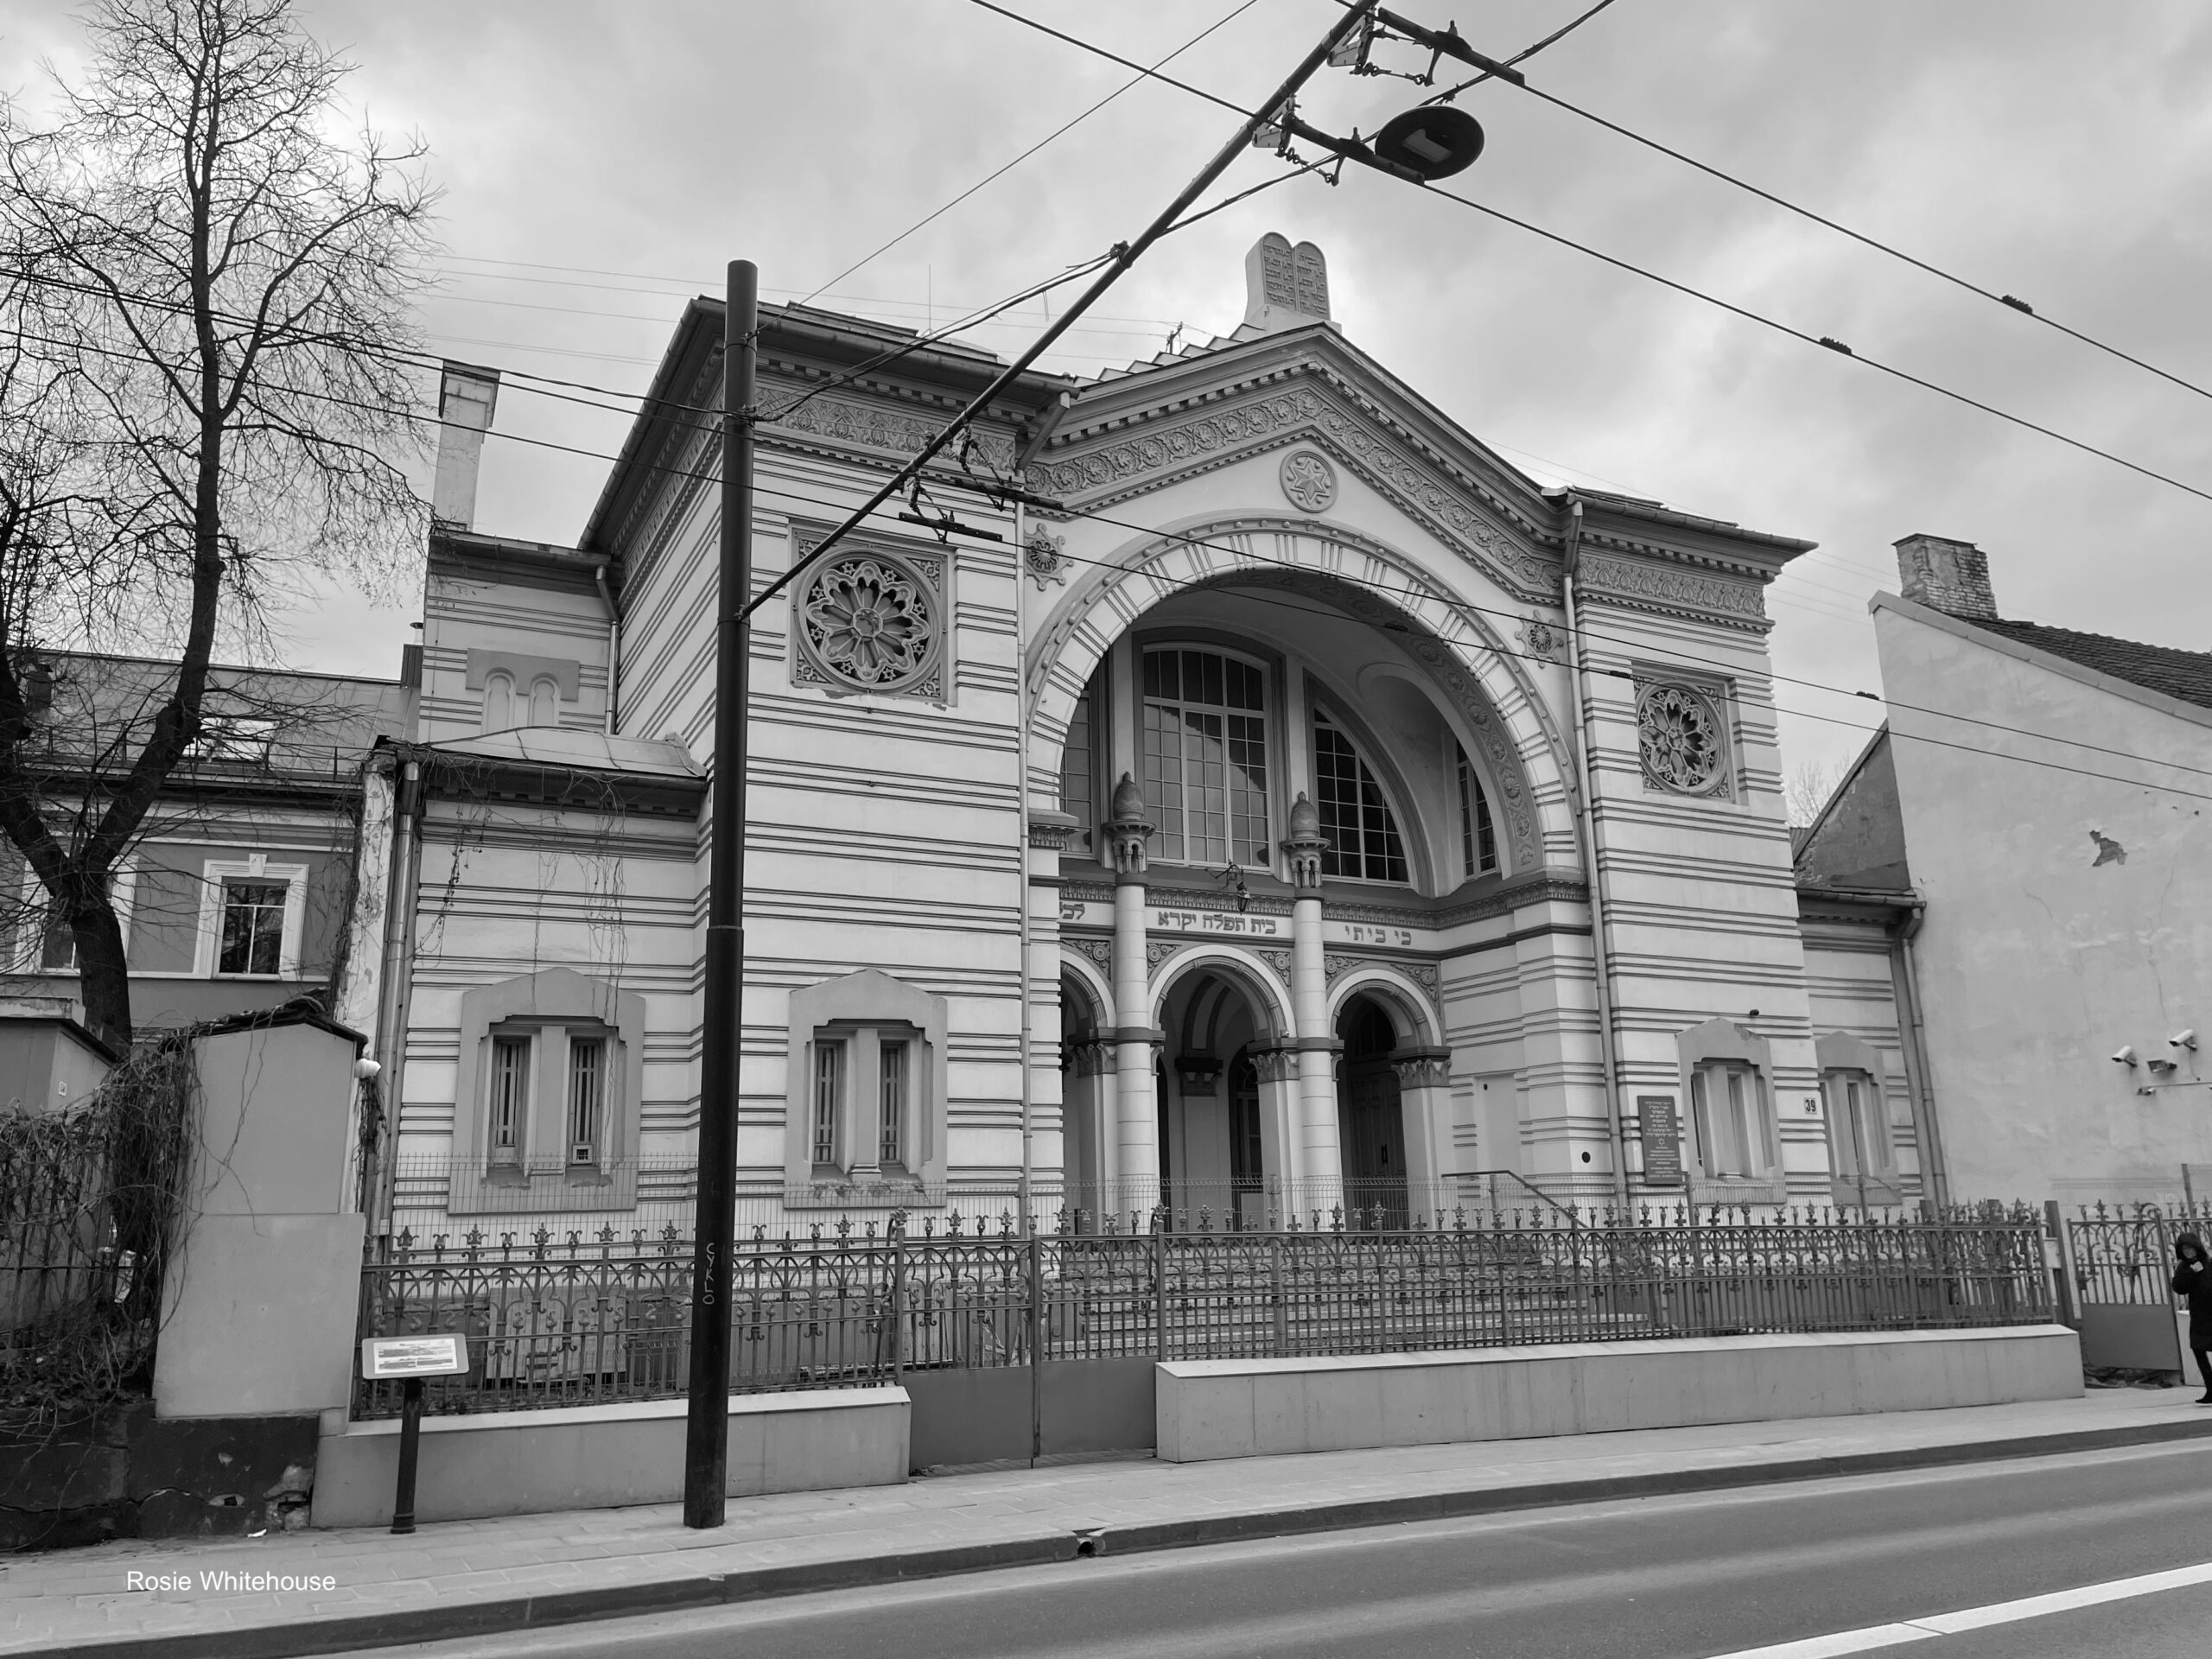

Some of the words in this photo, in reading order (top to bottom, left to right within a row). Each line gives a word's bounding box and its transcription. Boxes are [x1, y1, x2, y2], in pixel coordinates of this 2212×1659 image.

[1158, 910, 1197, 931] יקרא
[1250, 918, 1277, 934] בית
[1344, 925, 1386, 944] ביתי
[1394, 930, 1412, 946] כי
[1805, 1099, 1816, 1112] 39
